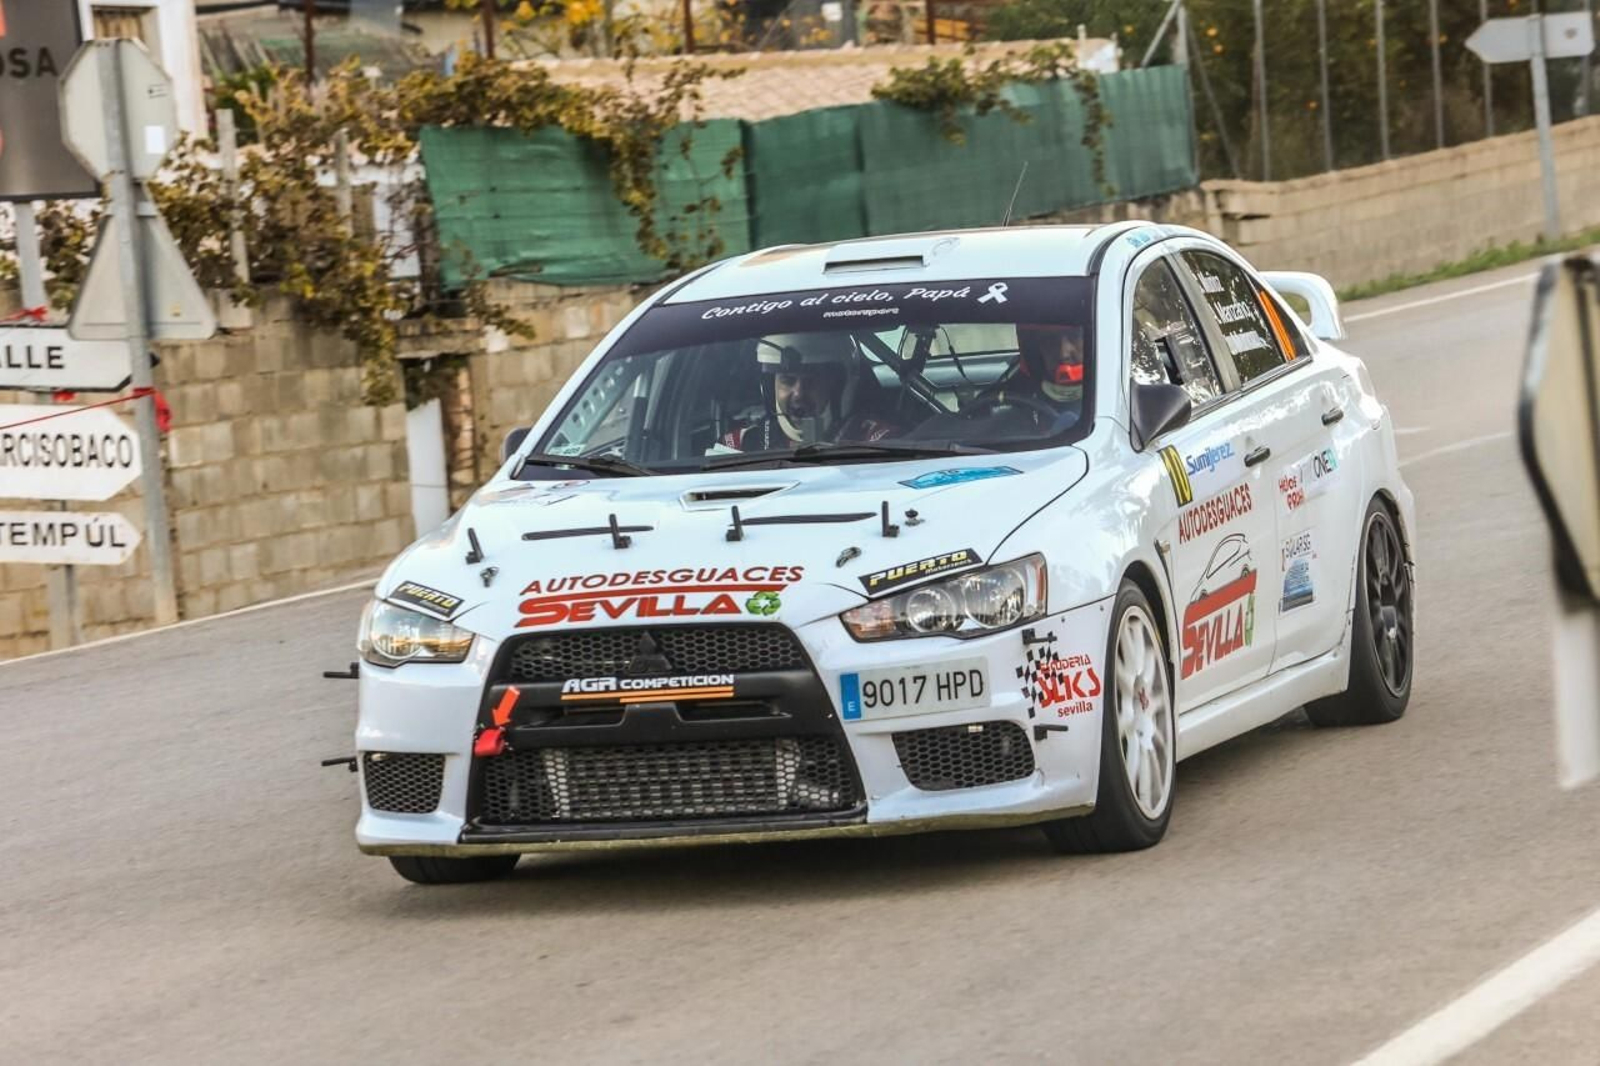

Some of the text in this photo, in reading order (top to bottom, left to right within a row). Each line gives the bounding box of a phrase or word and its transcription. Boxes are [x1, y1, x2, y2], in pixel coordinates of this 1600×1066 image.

[0, 46, 60, 79] SA
[701, 299, 793, 320] Contigo
[800, 293, 829, 307] al
[903, 286, 971, 301] Papá
[0, 345, 65, 370] LLE
[0, 433, 133, 468] RCISOBACO
[1178, 482, 1252, 545] AUTODESGUACES
[519, 565, 805, 596] AUTODESGUACES
[869, 550, 968, 587] PUERTO
[514, 594, 742, 628] SEVILLA
[1180, 603, 1244, 680] SEVILLA
[562, 673, 735, 693] AGR COMPETICION
[862, 668, 984, 708] 9017 HPD
[846, 701, 856, 712] E
[1056, 700, 1094, 718] sevilla
